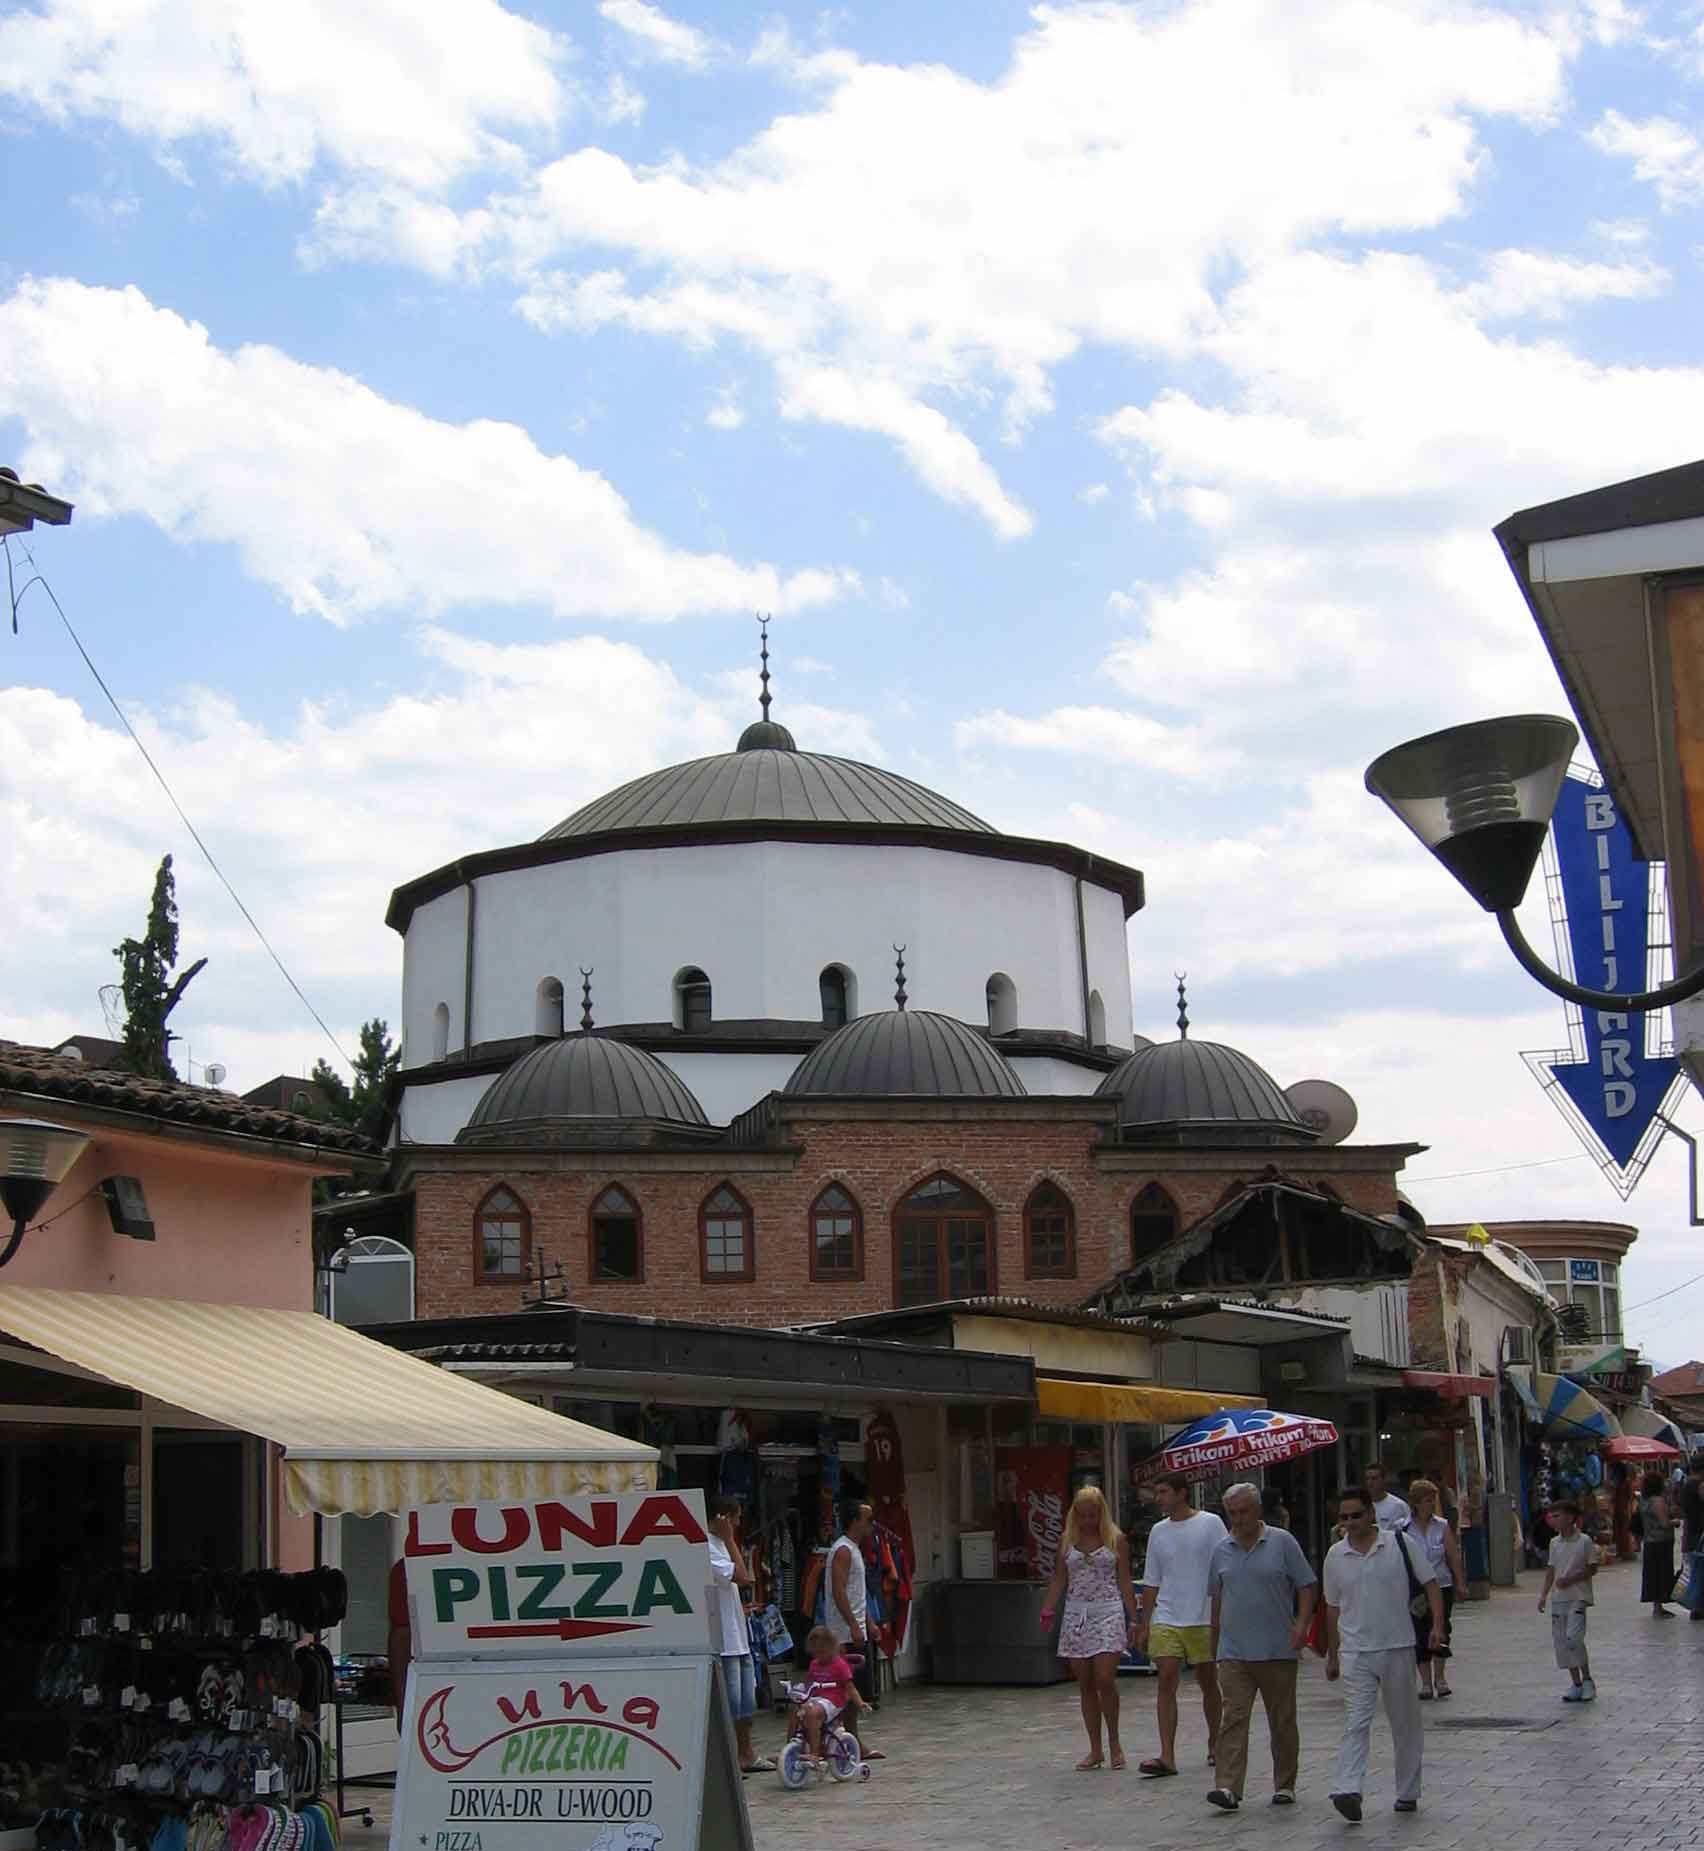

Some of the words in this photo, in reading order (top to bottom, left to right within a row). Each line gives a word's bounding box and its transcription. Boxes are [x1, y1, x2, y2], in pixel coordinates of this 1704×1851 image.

[1584, 794, 1636, 1118] BILIJARD
[873, 1437, 891, 1461] 19
[1246, 1428, 1304, 1450] Frikom
[1172, 1444, 1234, 1467] Frikom
[404, 1496, 708, 1557] LUNA
[432, 1559, 693, 1622] PIZZA
[501, 1725, 629, 1775] PIZZERIA
[449, 1788, 543, 1817] DRVA-DR
[557, 1788, 653, 1818] U-WOOD
[434, 1831, 483, 1851] PIZZA
